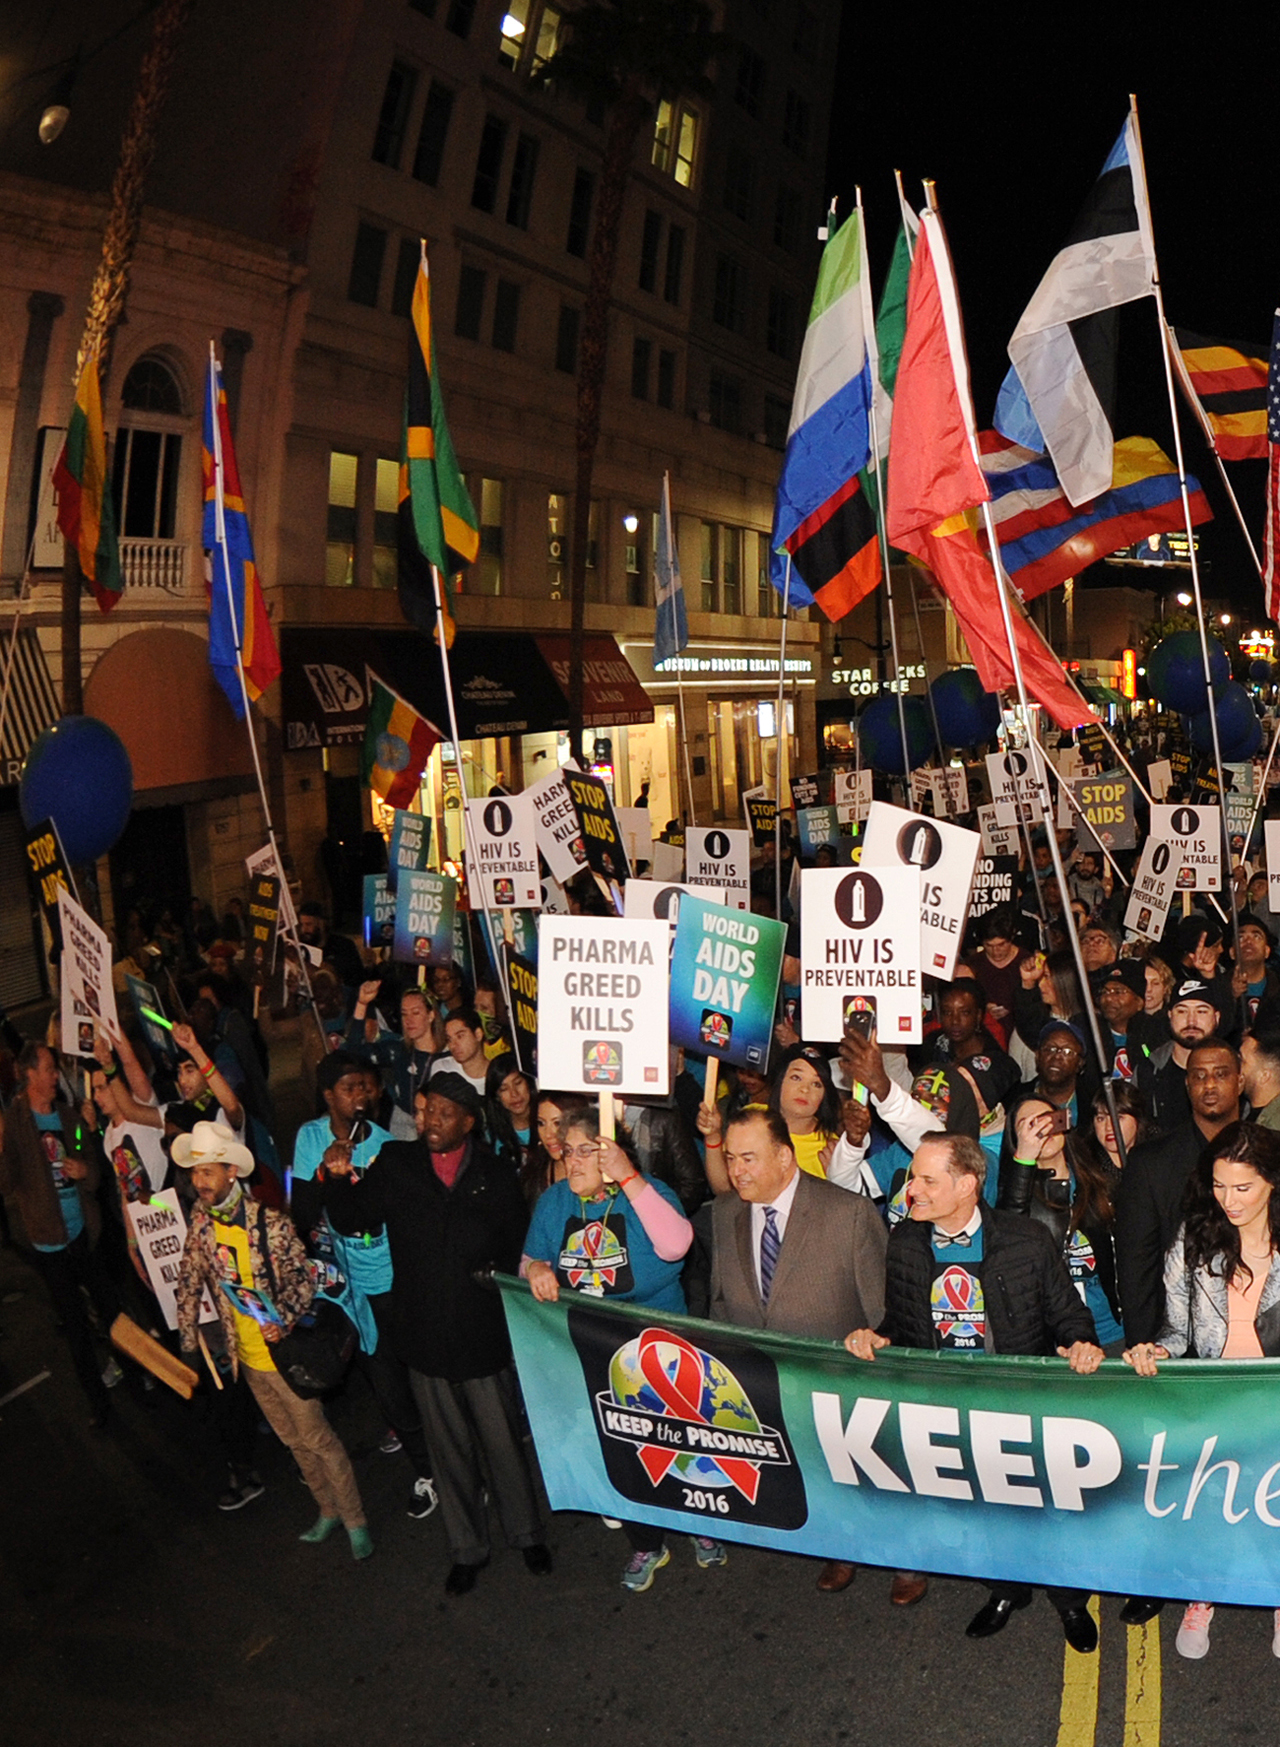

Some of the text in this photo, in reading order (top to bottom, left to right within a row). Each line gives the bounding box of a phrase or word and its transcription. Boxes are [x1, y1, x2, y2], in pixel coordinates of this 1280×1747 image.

[553, 660, 635, 685] SVENIR
[749, 658, 812, 672] RELATINSHIPS
[831, 665, 926, 684] STARCKS
[593, 690, 624, 704] LAND
[1171, 752, 1191, 765] STOP
[1025, 778, 1037, 790] IS
[1081, 784, 1127, 805] STOP
[570, 780, 606, 812] STOP
[541, 799, 573, 830] GREE
[751, 803, 776, 817] STOP
[1086, 805, 1126, 825] AIDS
[1226, 806, 1252, 819] AIDS
[552, 817, 581, 844] KILL
[583, 815, 616, 844] AIDS
[807, 818, 831, 831] AIDS
[1226, 819, 1250, 834] DAY
[399, 830, 423, 850] AIDS
[808, 829, 831, 845] DAY
[990, 832, 1010, 843] KILLS
[1193, 840, 1206, 853] IS
[27, 832, 56, 872] STOP
[397, 847, 420, 870] DAY
[480, 841, 522, 860] HIV IS
[469, 860, 536, 874] PEVENTABLE
[699, 862, 737, 876] HIV IS
[976, 858, 995, 874] NO
[410, 877, 443, 893] WORLD
[688, 876, 748, 889] PREVENTABLE
[972, 873, 1012, 889] NDING
[1141, 875, 1166, 897] HIV IS
[408, 893, 443, 914] AIDS
[991, 888, 1011, 902] ON
[1132, 888, 1168, 912] PREVENTABLE
[968, 903, 999, 918] AID
[63, 903, 104, 958] PHARMA
[407, 912, 440, 936] DAY
[702, 912, 760, 945] WORLD
[70, 930, 102, 972] GREED
[553, 937, 655, 965] PHARMA
[695, 939, 756, 979] AIDS
[825, 938, 894, 964] HIV IS
[564, 972, 642, 999] GREED
[805, 969, 917, 988] PREVENTABLE
[692, 969, 749, 1014] DAY
[516, 1001, 538, 1034] AID
[570, 1006, 635, 1033] KILLS
[136, 1209, 179, 1237] PHARMA
[149, 1234, 181, 1260] GREED
[954, 1337, 976, 1347] 2016
[605, 1410, 780, 1459] KEEP the PROMISE
[811, 1391, 1122, 1512] KEEP
[681, 1488, 730, 1514] 2016
